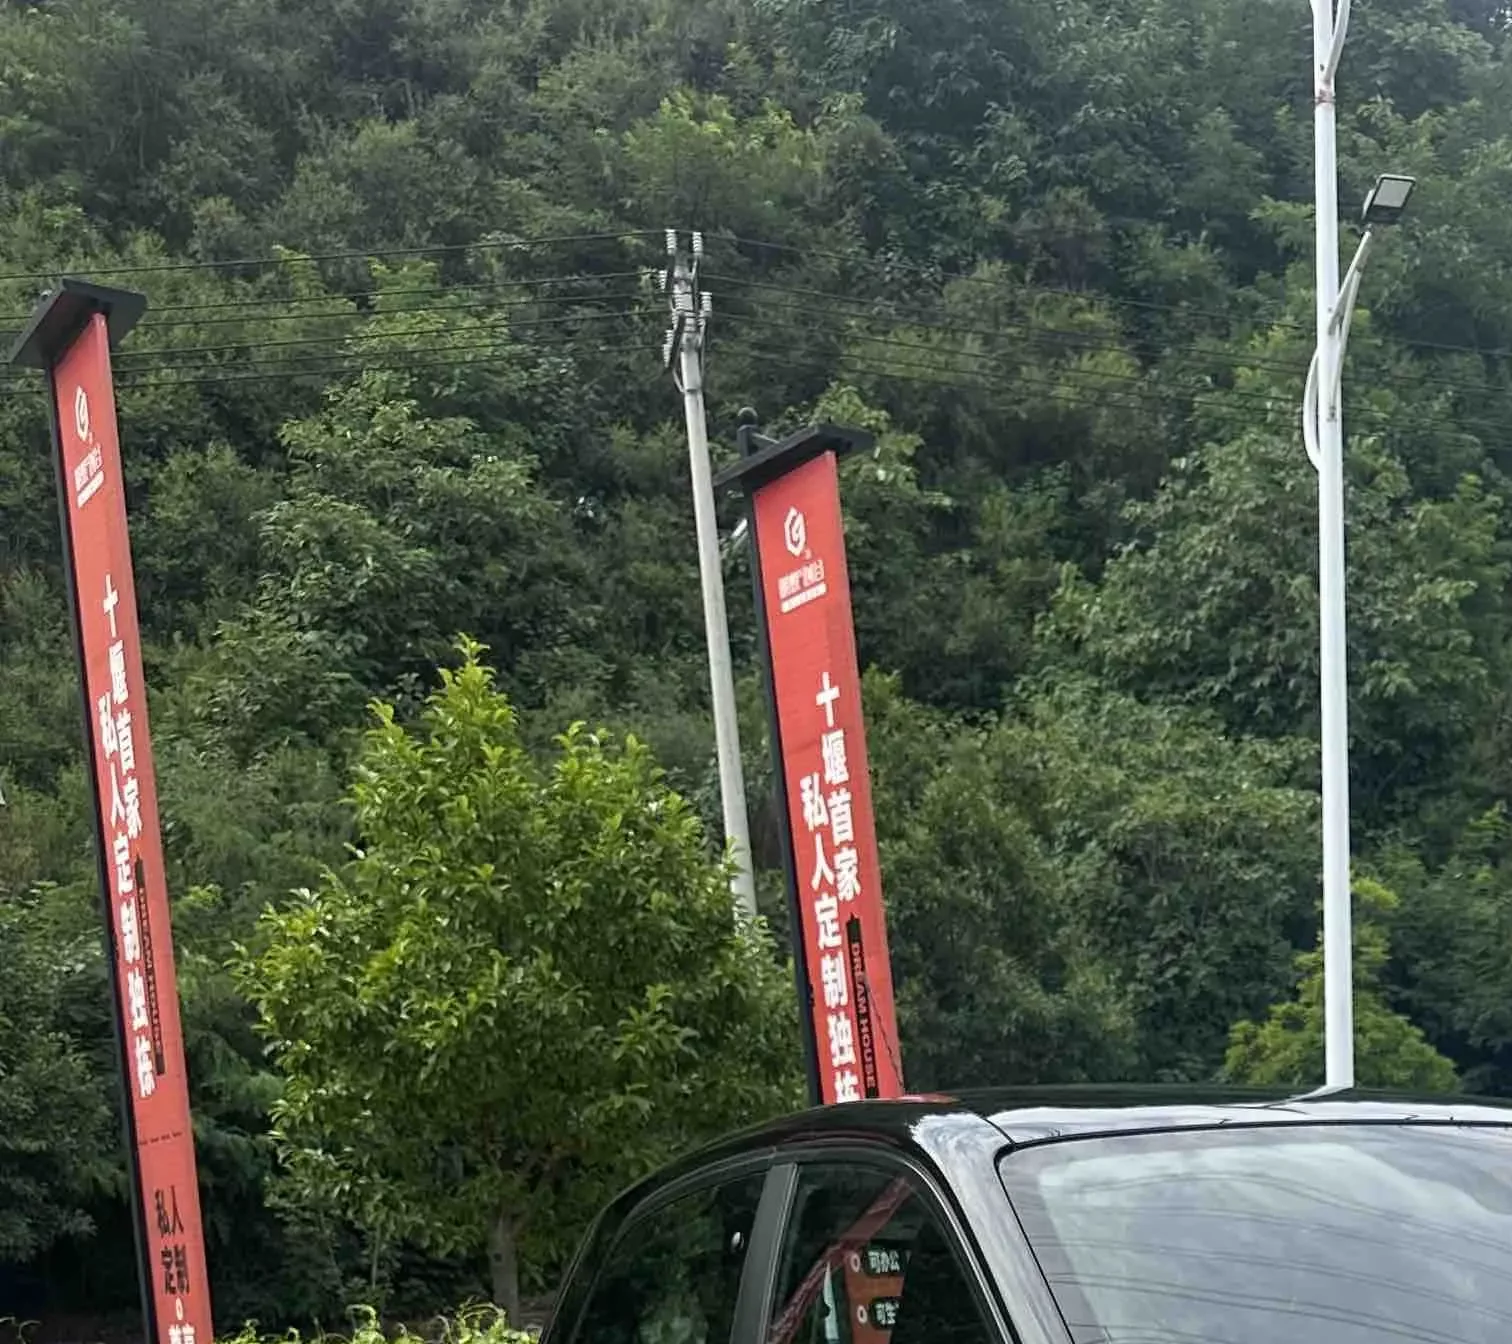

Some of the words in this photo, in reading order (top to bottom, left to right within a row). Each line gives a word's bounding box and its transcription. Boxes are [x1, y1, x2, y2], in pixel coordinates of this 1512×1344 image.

[103, 573, 143, 839] 十堰首家
[816, 671, 861, 902] 十堰首家
[851, 942, 867, 1014] DREAM
[859, 1016, 876, 1088] HOUSE
[155, 1185, 184, 1237] 私人
